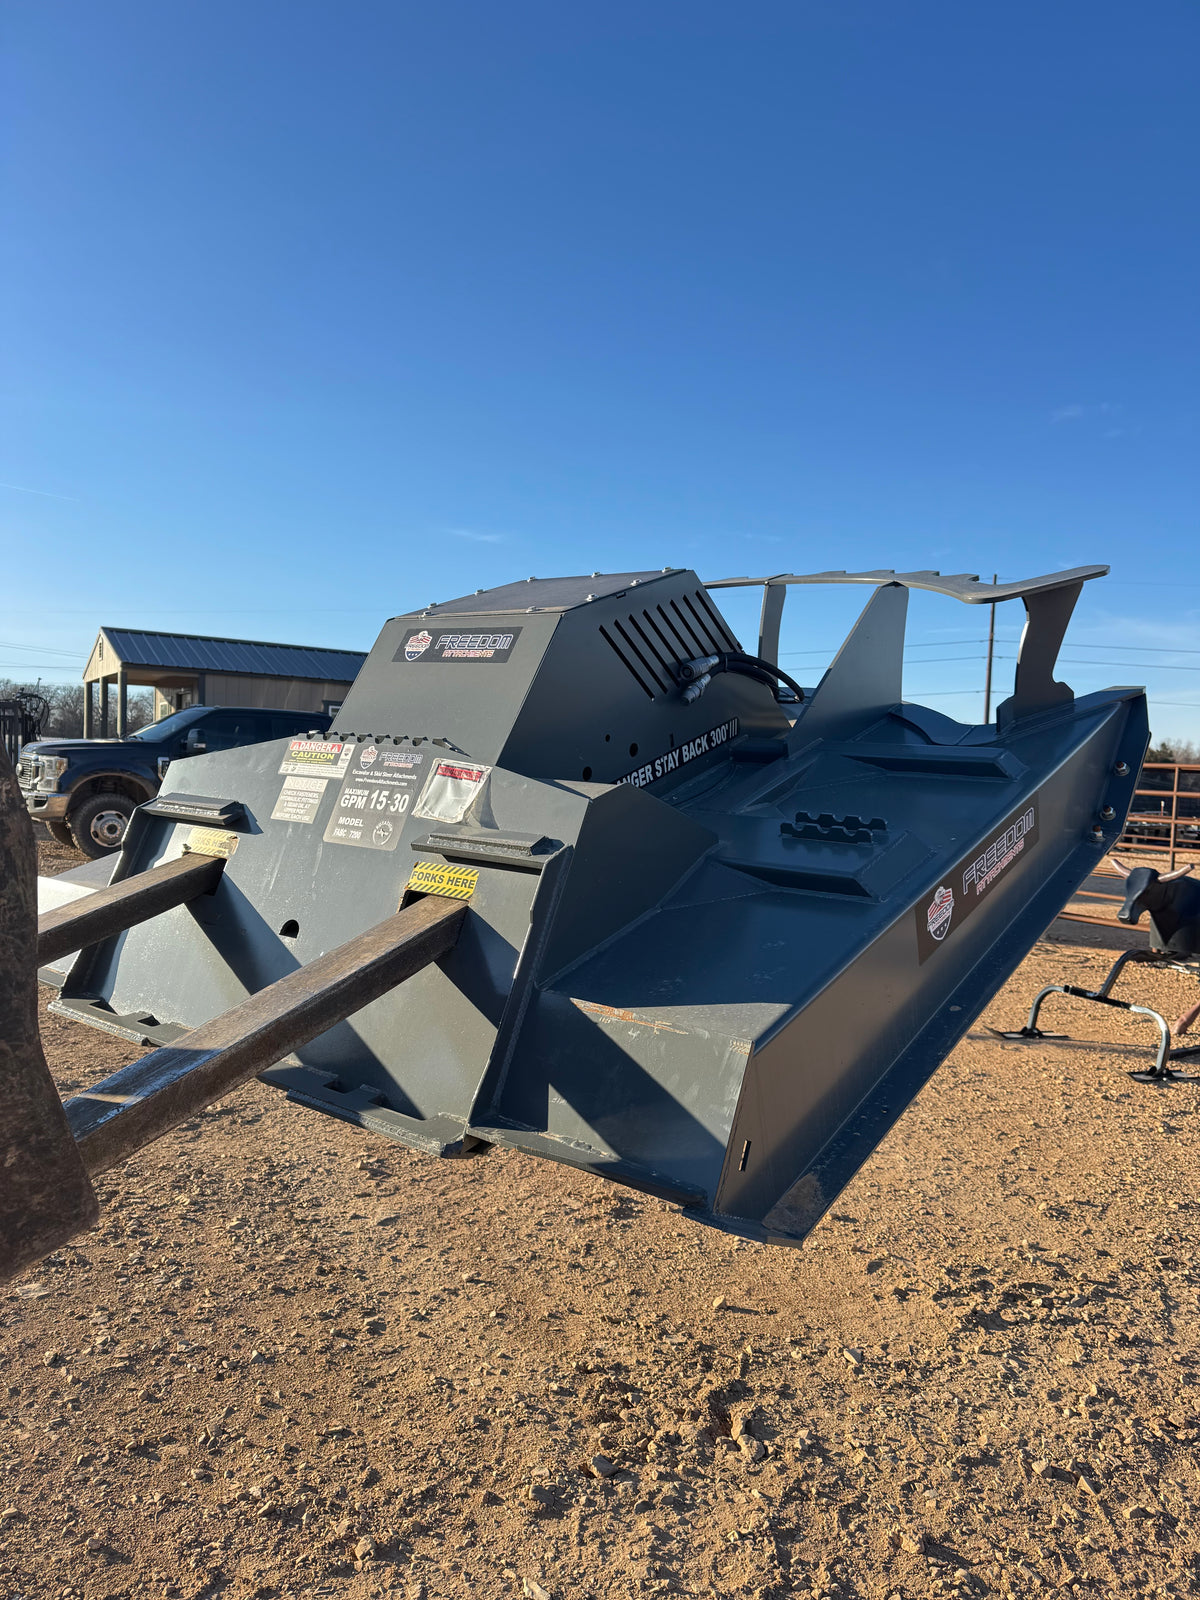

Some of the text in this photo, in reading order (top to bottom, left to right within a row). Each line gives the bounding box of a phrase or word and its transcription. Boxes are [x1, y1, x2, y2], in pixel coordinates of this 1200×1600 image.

[435, 634, 514, 650] FREEDOM
[299, 742, 333, 752] DANGER
[292, 751, 335, 760] CAUTION
[378, 752, 424, 764] FREEDOM
[654, 748, 680, 778] STAY
[682, 733, 709, 763] BACK
[287, 778, 324, 790] NOTICE
[344, 788, 370, 796] MAXIMUM
[340, 789, 410, 812] GPM 15-30
[338, 816, 364, 827] MODEL
[962, 807, 1034, 896] FREEDOM
[976, 838, 1025, 896] ATTACHMENTS
[411, 870, 476, 889] FORKS HERE
